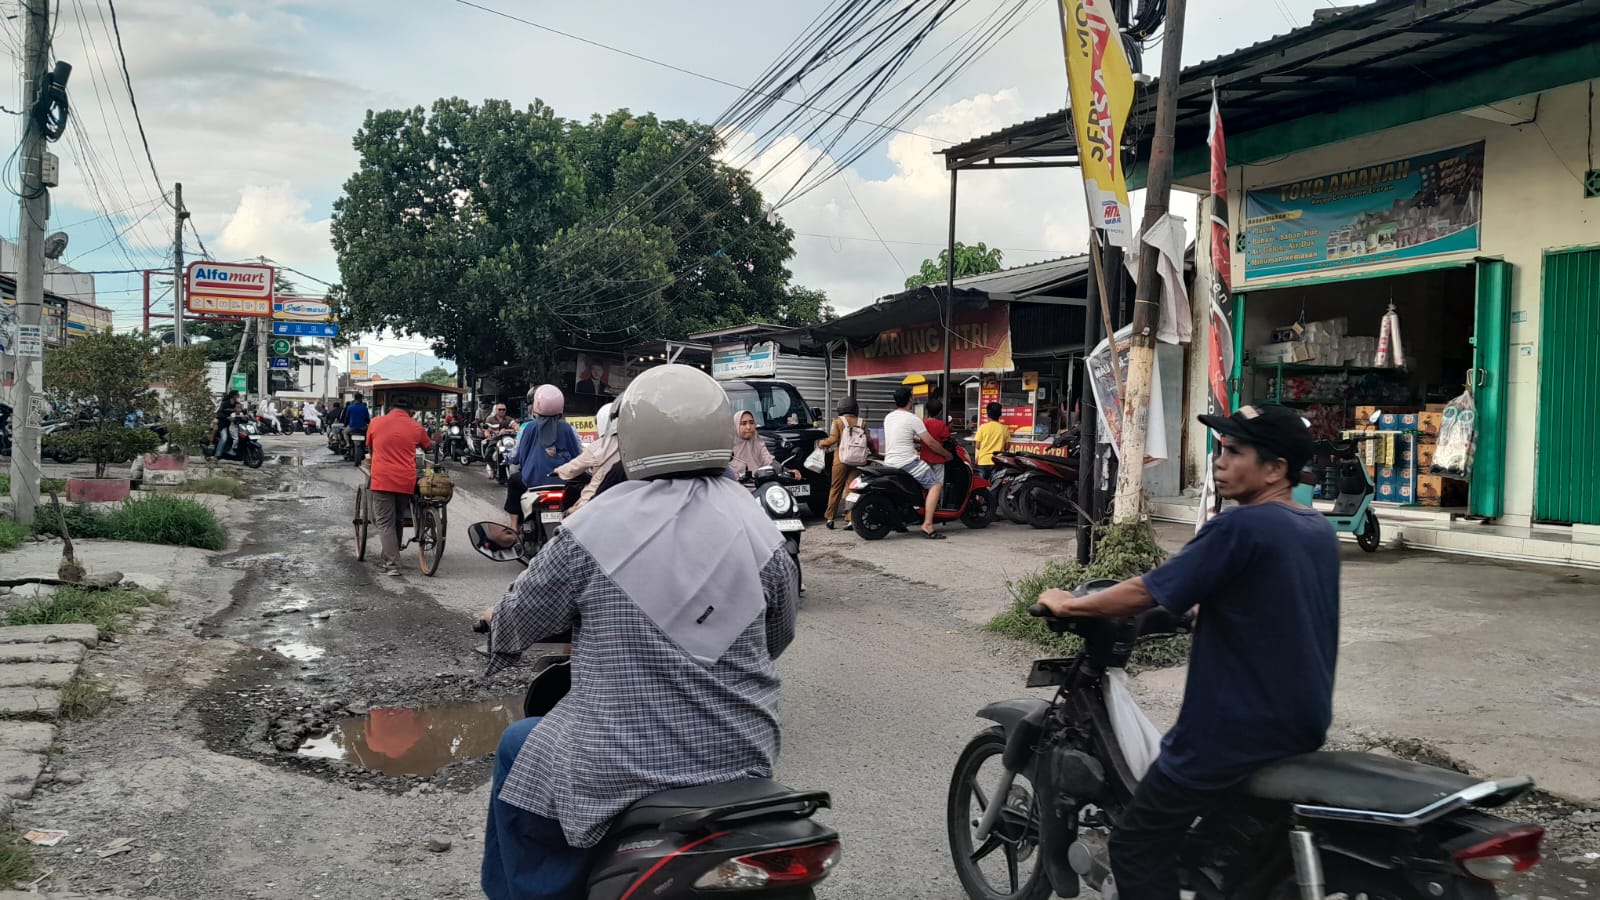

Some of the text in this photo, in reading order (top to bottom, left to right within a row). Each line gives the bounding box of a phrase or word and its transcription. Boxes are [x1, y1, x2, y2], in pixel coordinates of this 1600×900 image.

[1279, 178, 1325, 203] TOKO
[1327, 160, 1411, 193] AMANAH
[195, 267, 265, 284] Alfamart
[862, 327, 940, 359] WARUNG
[1008, 444, 1041, 457] ARUNG
